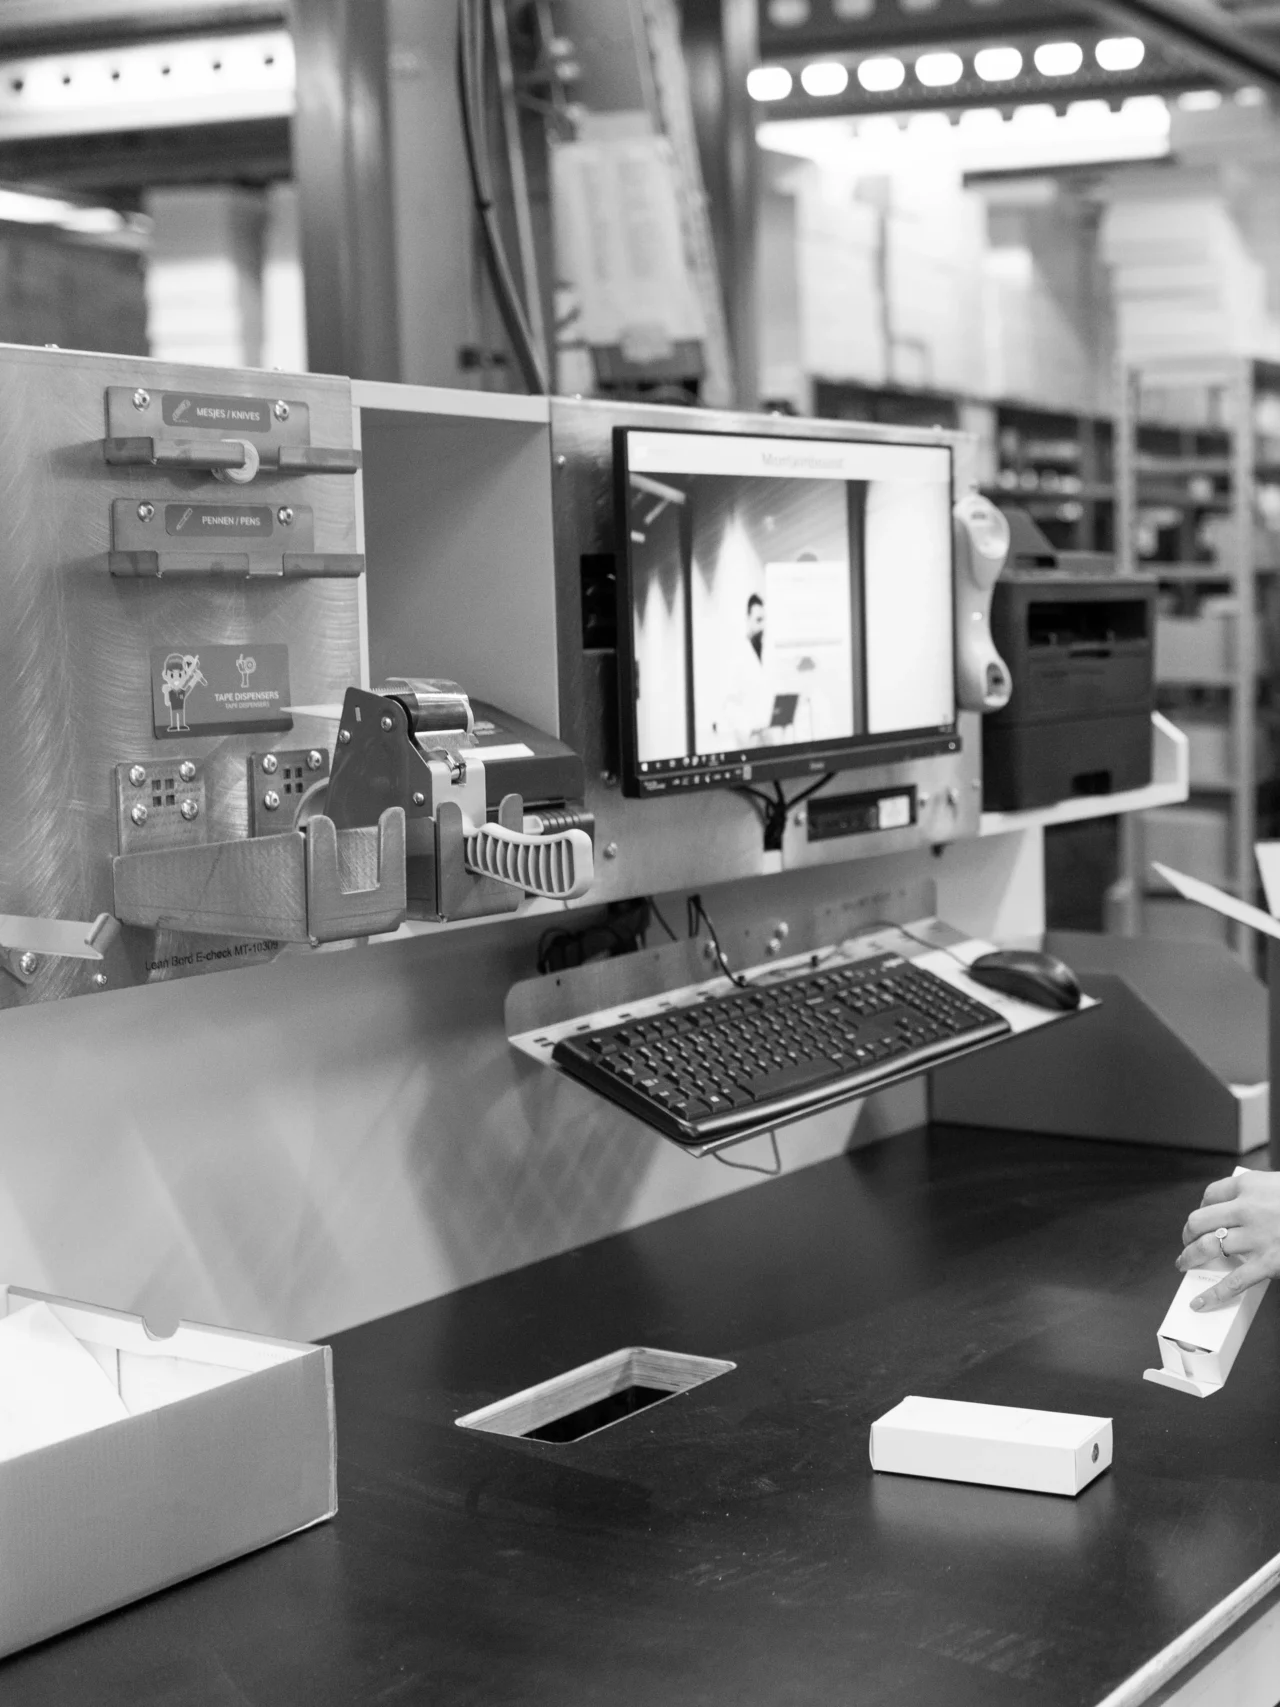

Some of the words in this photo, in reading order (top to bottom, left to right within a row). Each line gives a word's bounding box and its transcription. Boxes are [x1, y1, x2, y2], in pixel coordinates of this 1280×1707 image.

[196, 407, 226, 419] MESJES
[231, 410, 261, 421] KNIVES
[201, 515, 235, 526] PENNEN
[240, 516, 261, 526] PENS
[214, 692, 234, 702] TAPE
[234, 690, 280, 701] DISPENSERS
[196, 947, 232, 963] E-check
